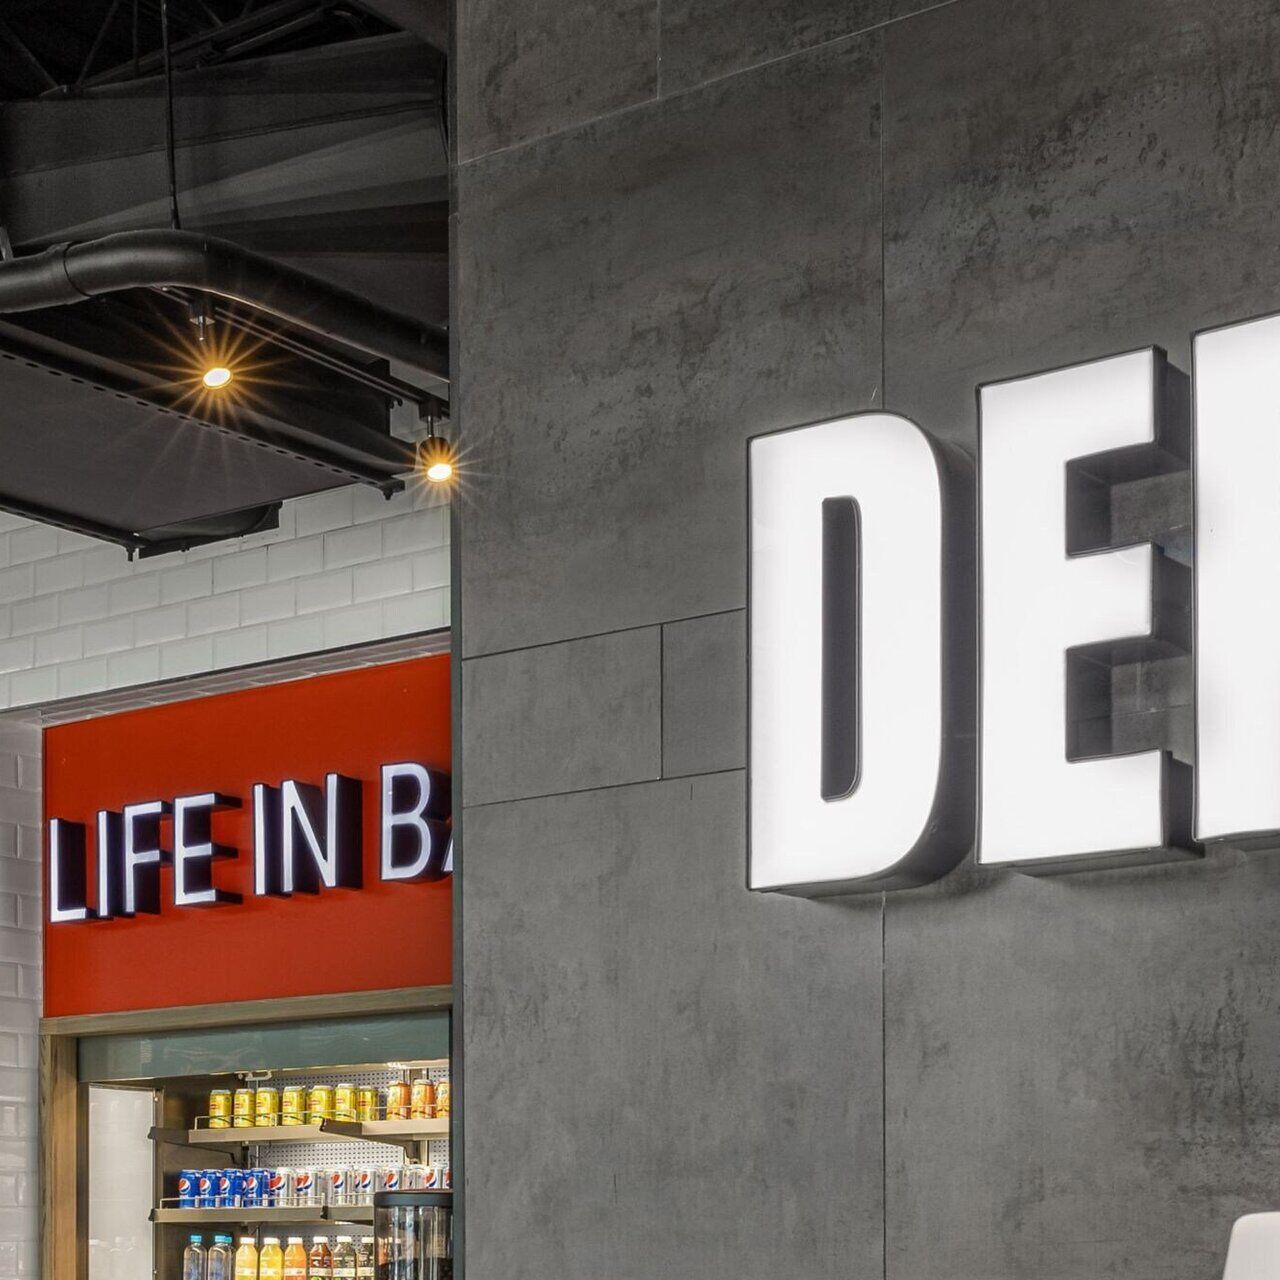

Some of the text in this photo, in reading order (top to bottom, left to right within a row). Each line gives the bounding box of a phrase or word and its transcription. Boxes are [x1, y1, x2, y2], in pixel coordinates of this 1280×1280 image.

[49, 761, 453, 923] LIFE IN B
